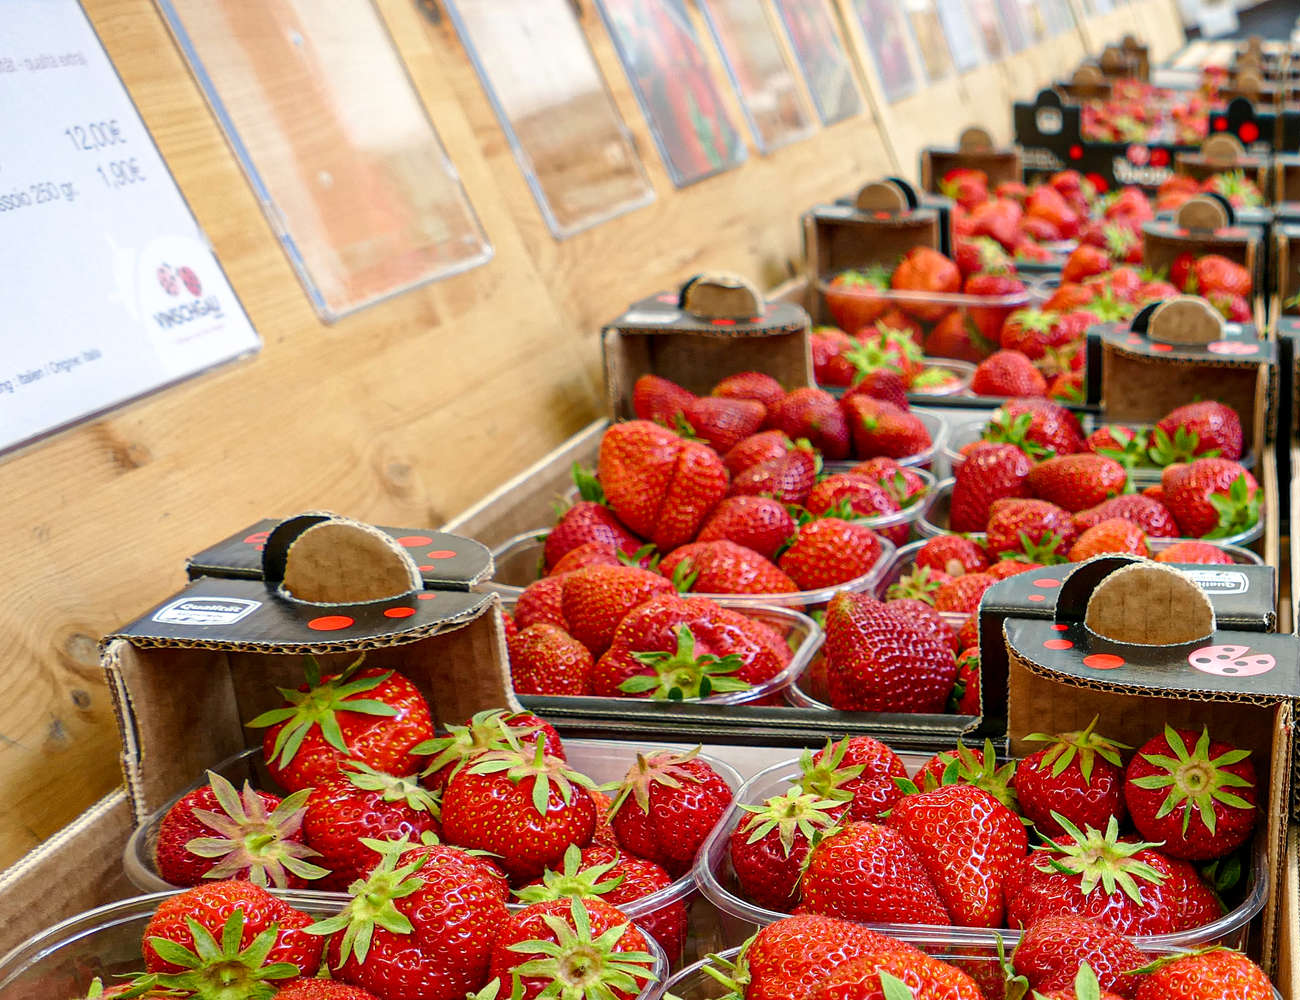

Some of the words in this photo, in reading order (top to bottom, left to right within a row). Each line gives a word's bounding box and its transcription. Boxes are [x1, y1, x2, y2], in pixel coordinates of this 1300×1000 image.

[65, 120, 126, 151] 12,00€
[30, 182, 60, 204] 250
[97, 157, 147, 190] 1,90€
